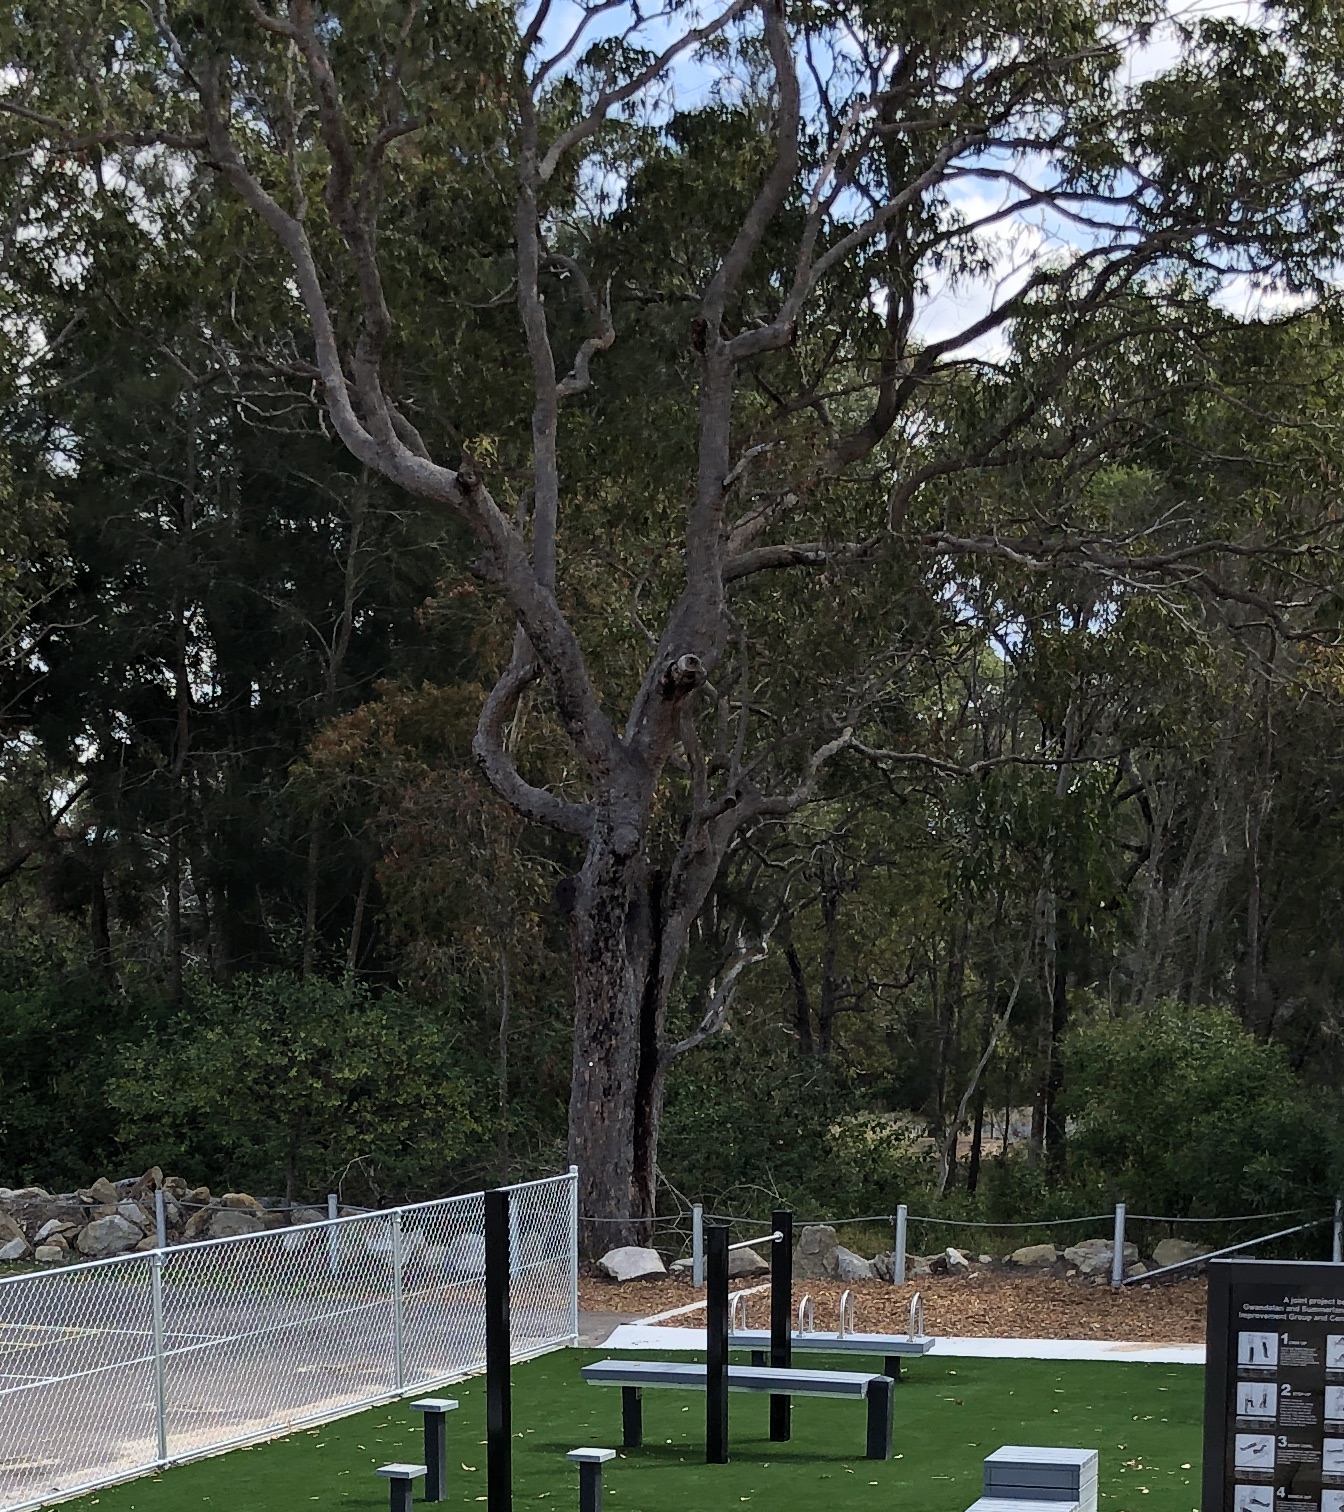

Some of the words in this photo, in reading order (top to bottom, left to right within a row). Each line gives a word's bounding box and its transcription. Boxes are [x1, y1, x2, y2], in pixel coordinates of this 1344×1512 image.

[1283, 1296, 1290, 1304] A
[1290, 1297, 1308, 1305] joint
[1309, 1297, 1336, 1306] project
[1238, 1311, 1287, 1320] Improvement
[1288, 1313, 1313, 1322] Group
[1280, 1332, 1289, 1345] 1
[1280, 1383, 1292, 1396] 2
[1277, 1435, 1288, 1448] 3
[1276, 1486, 1286, 1498] 4
